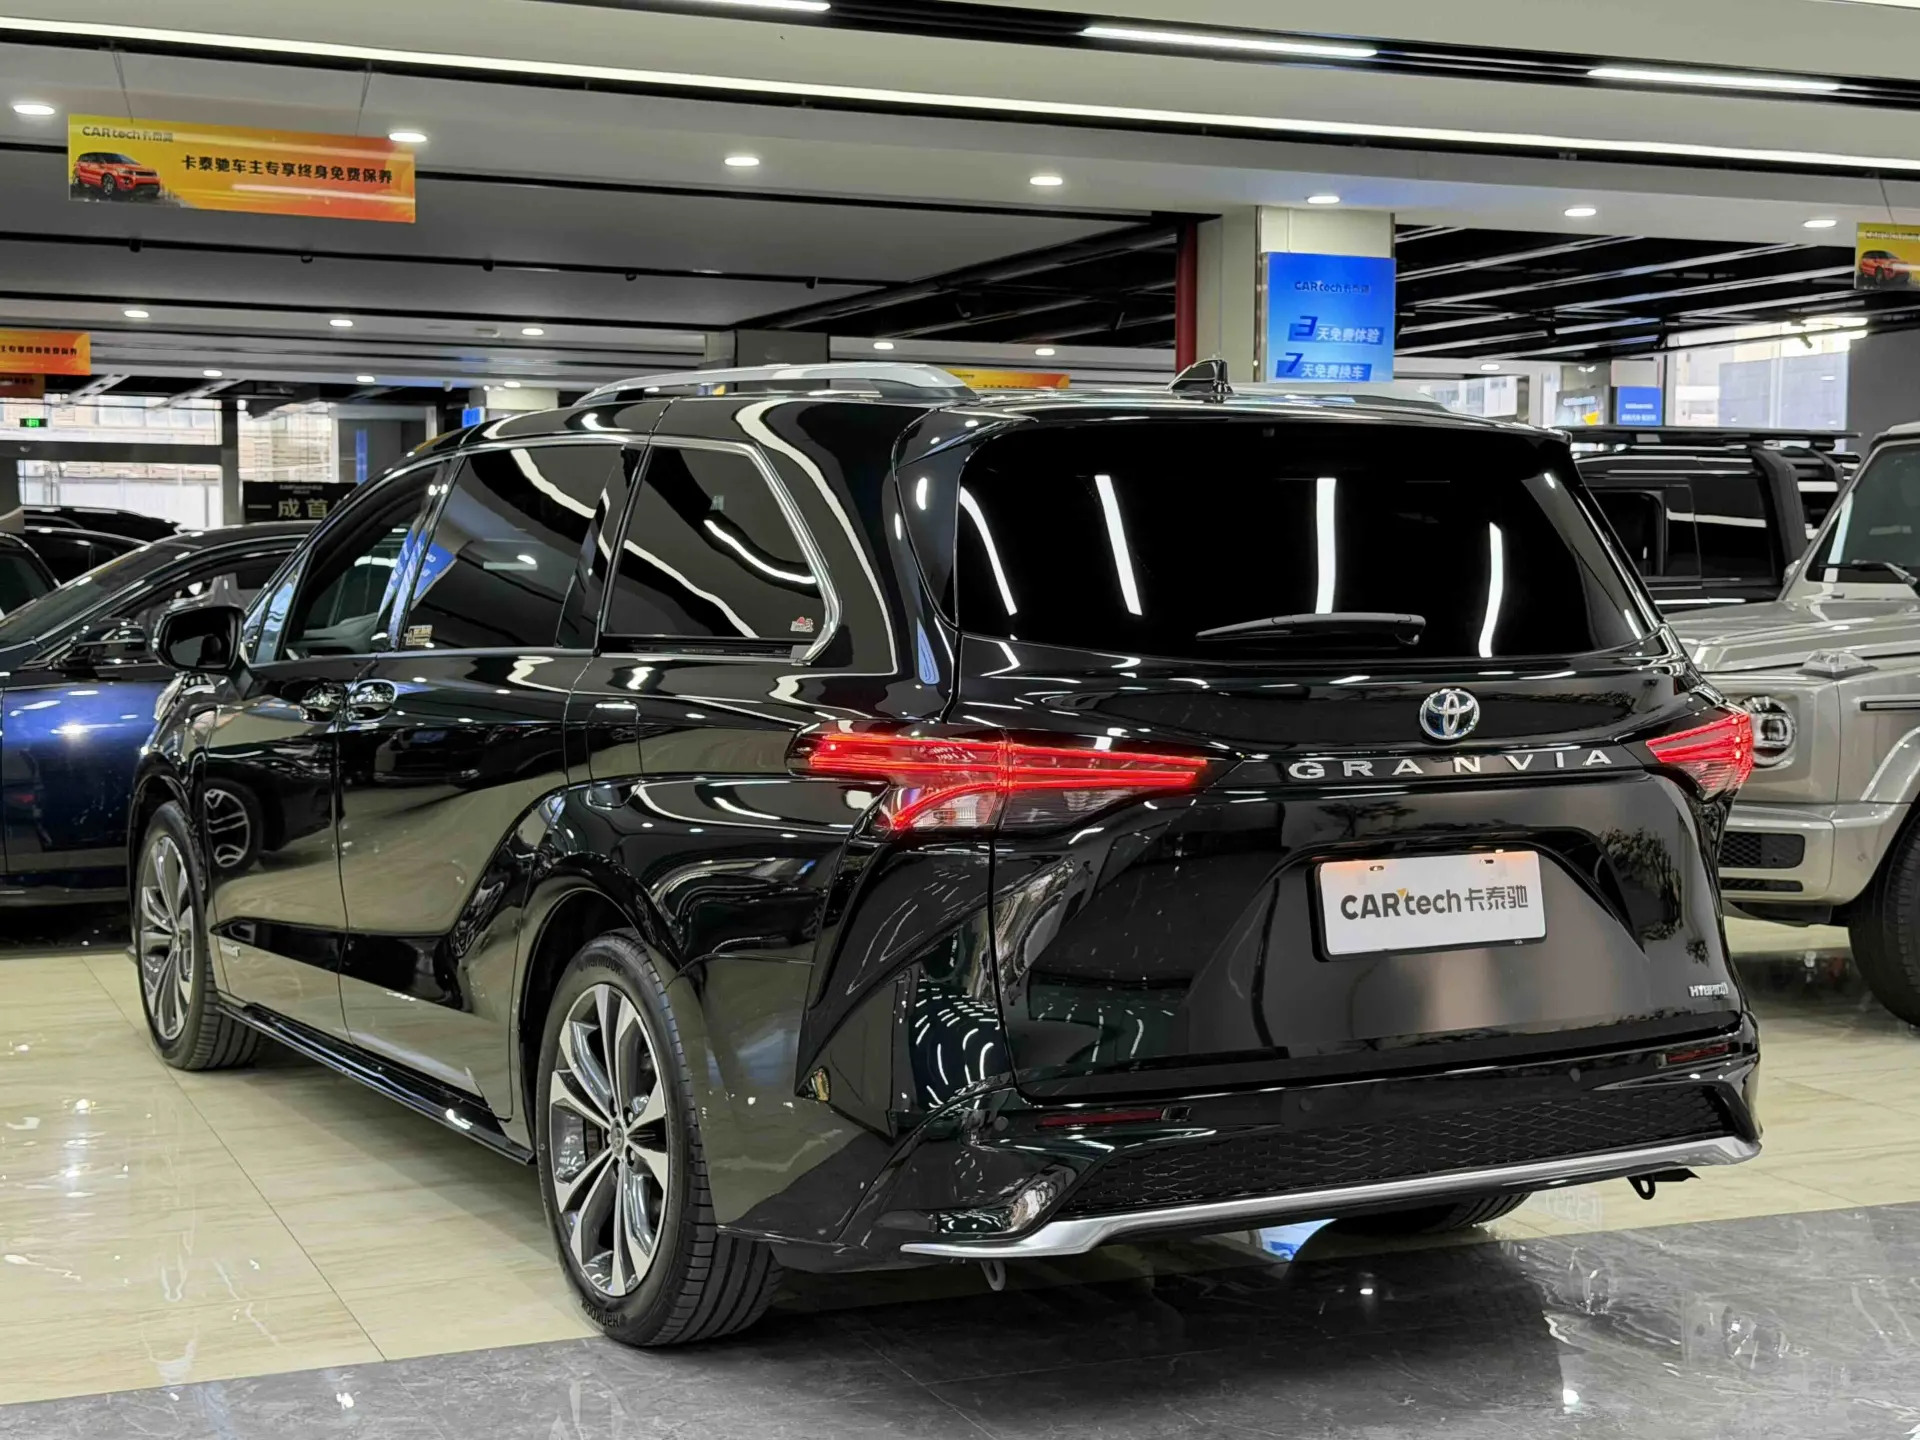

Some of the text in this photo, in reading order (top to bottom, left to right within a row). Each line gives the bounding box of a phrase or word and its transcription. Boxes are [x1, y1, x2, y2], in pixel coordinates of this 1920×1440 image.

[182, 155, 393, 184] 卡泰驰车主专享终身免费保养
[1288, 749, 1613, 780] GRANVIA
[1340, 885, 1529, 920] CARtech 卡泰驰
